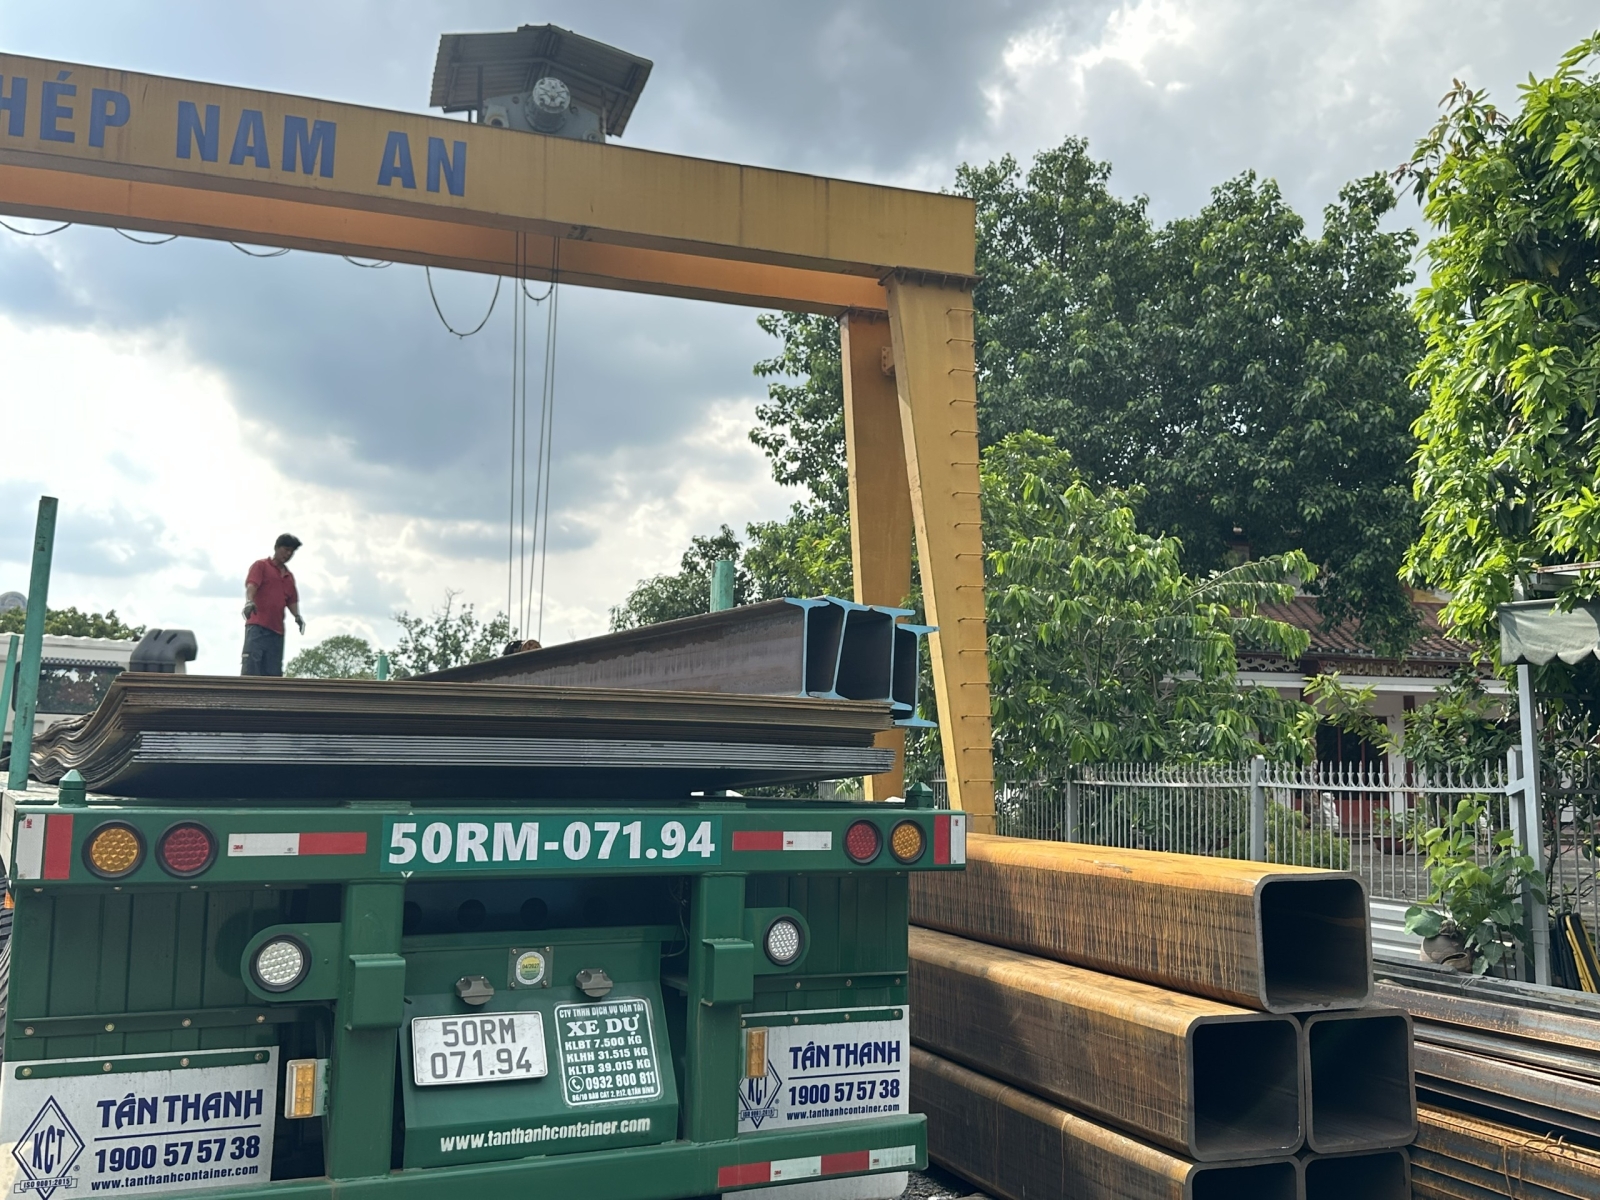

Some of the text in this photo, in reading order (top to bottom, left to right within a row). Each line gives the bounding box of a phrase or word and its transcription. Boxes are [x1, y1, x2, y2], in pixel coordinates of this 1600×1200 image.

[176, 100, 337, 178] NAM
[377, 131, 467, 197] AN
[388, 820, 715, 864] 50RM-071.94
[559, 1009, 571, 1018] CTY
[573, 1007, 590, 1017] TNHH
[592, 1006, 607, 1018] DỊCH
[566, 1014, 640, 1037] XE DỰ
[442, 1018, 516, 1047] 50RM
[565, 1035, 642, 1051] KLBT 7.500 KG
[430, 1047, 532, 1079] 071.94
[566, 1047, 648, 1063] KLHH 31.515 KG
[568, 1059, 651, 1075] KLTB 39.015 KG
[789, 1040, 900, 1071] TÂN THANH
[585, 1071, 656, 1090] 0932 800 811
[788, 1084, 830, 1106] 1900
[96, 1089, 263, 1130] TÂN THANH
[786, 1104, 900, 1120] www.tanthanhcontainer.com
[441, 1117, 651, 1152] www.tanthanhcontainer.com
[32, 1125, 65, 1174] KCT
[94, 1145, 157, 1173] 1900
[91, 1165, 259, 1191] www.tanthanhcontainer.com
